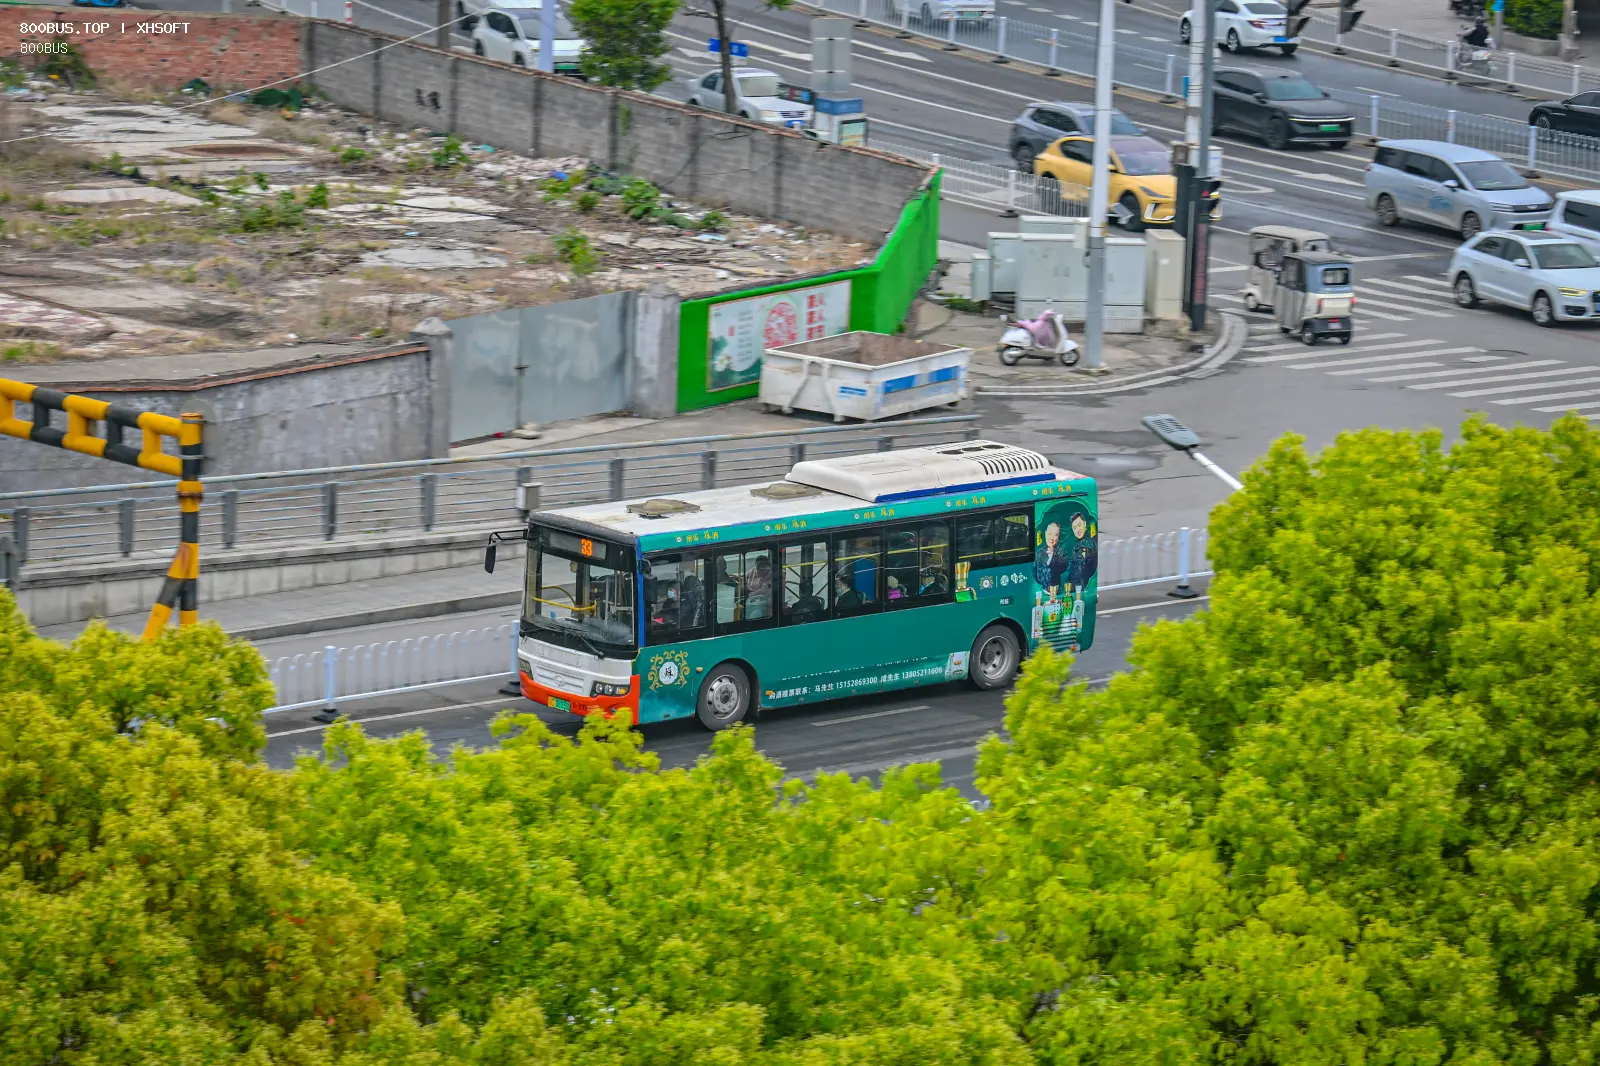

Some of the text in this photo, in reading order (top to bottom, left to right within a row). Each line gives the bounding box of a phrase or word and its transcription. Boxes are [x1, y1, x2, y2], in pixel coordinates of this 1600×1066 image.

[581, 538, 593, 557] 33
[836, 676, 878, 690] 15152869300
[902, 667, 943, 680] 13805211606
